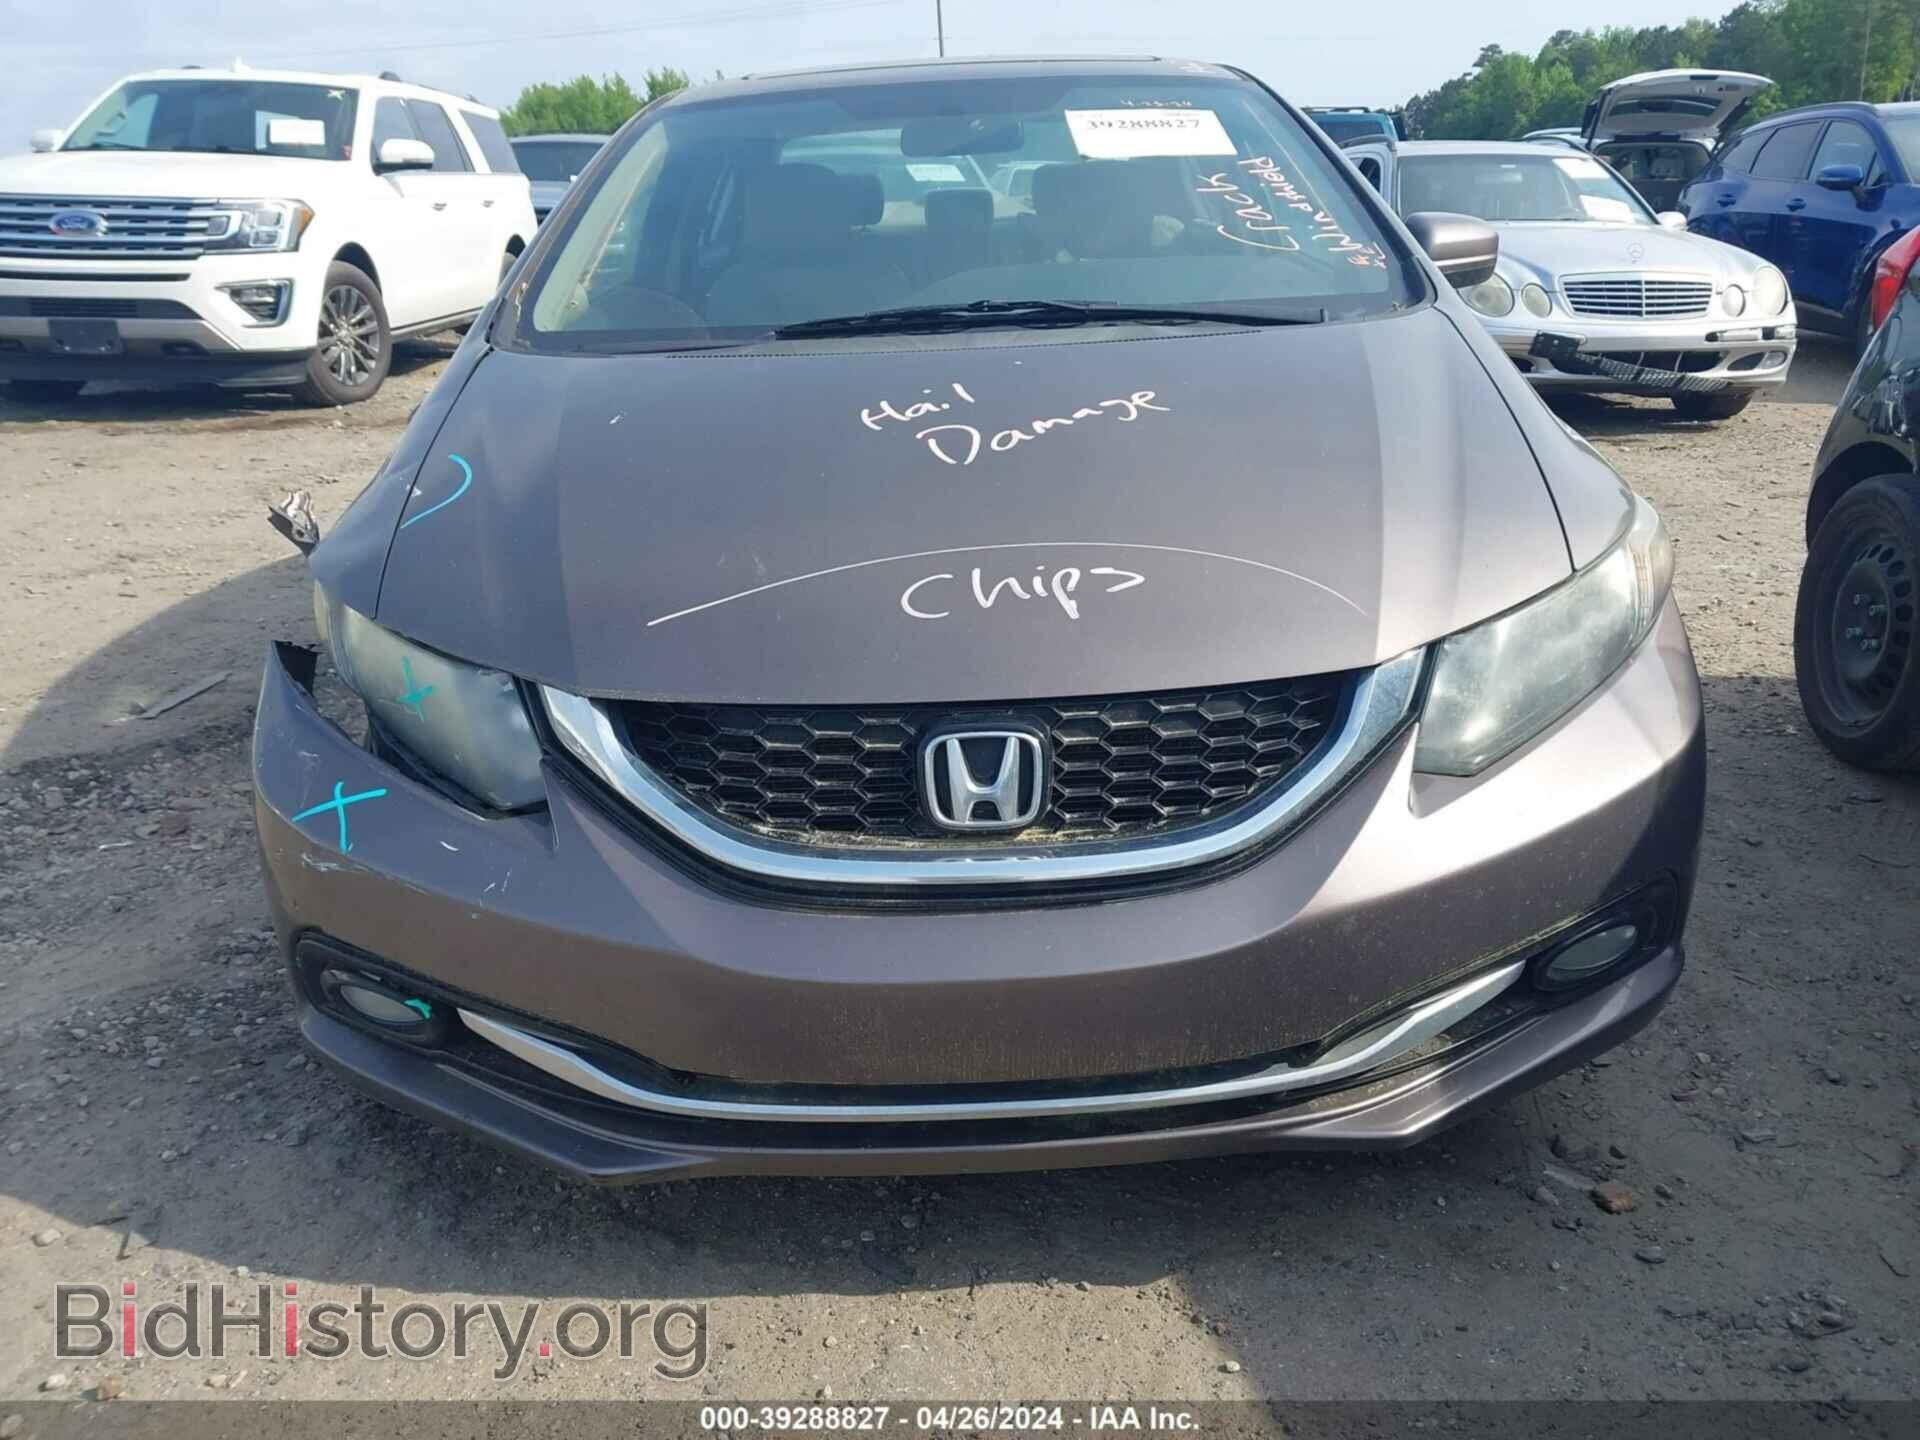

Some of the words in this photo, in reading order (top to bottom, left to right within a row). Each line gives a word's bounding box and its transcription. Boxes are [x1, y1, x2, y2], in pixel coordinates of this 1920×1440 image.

[860, 383, 976, 431] Hail
[915, 391, 1171, 464] Damage
[901, 565, 1146, 619] Chips
